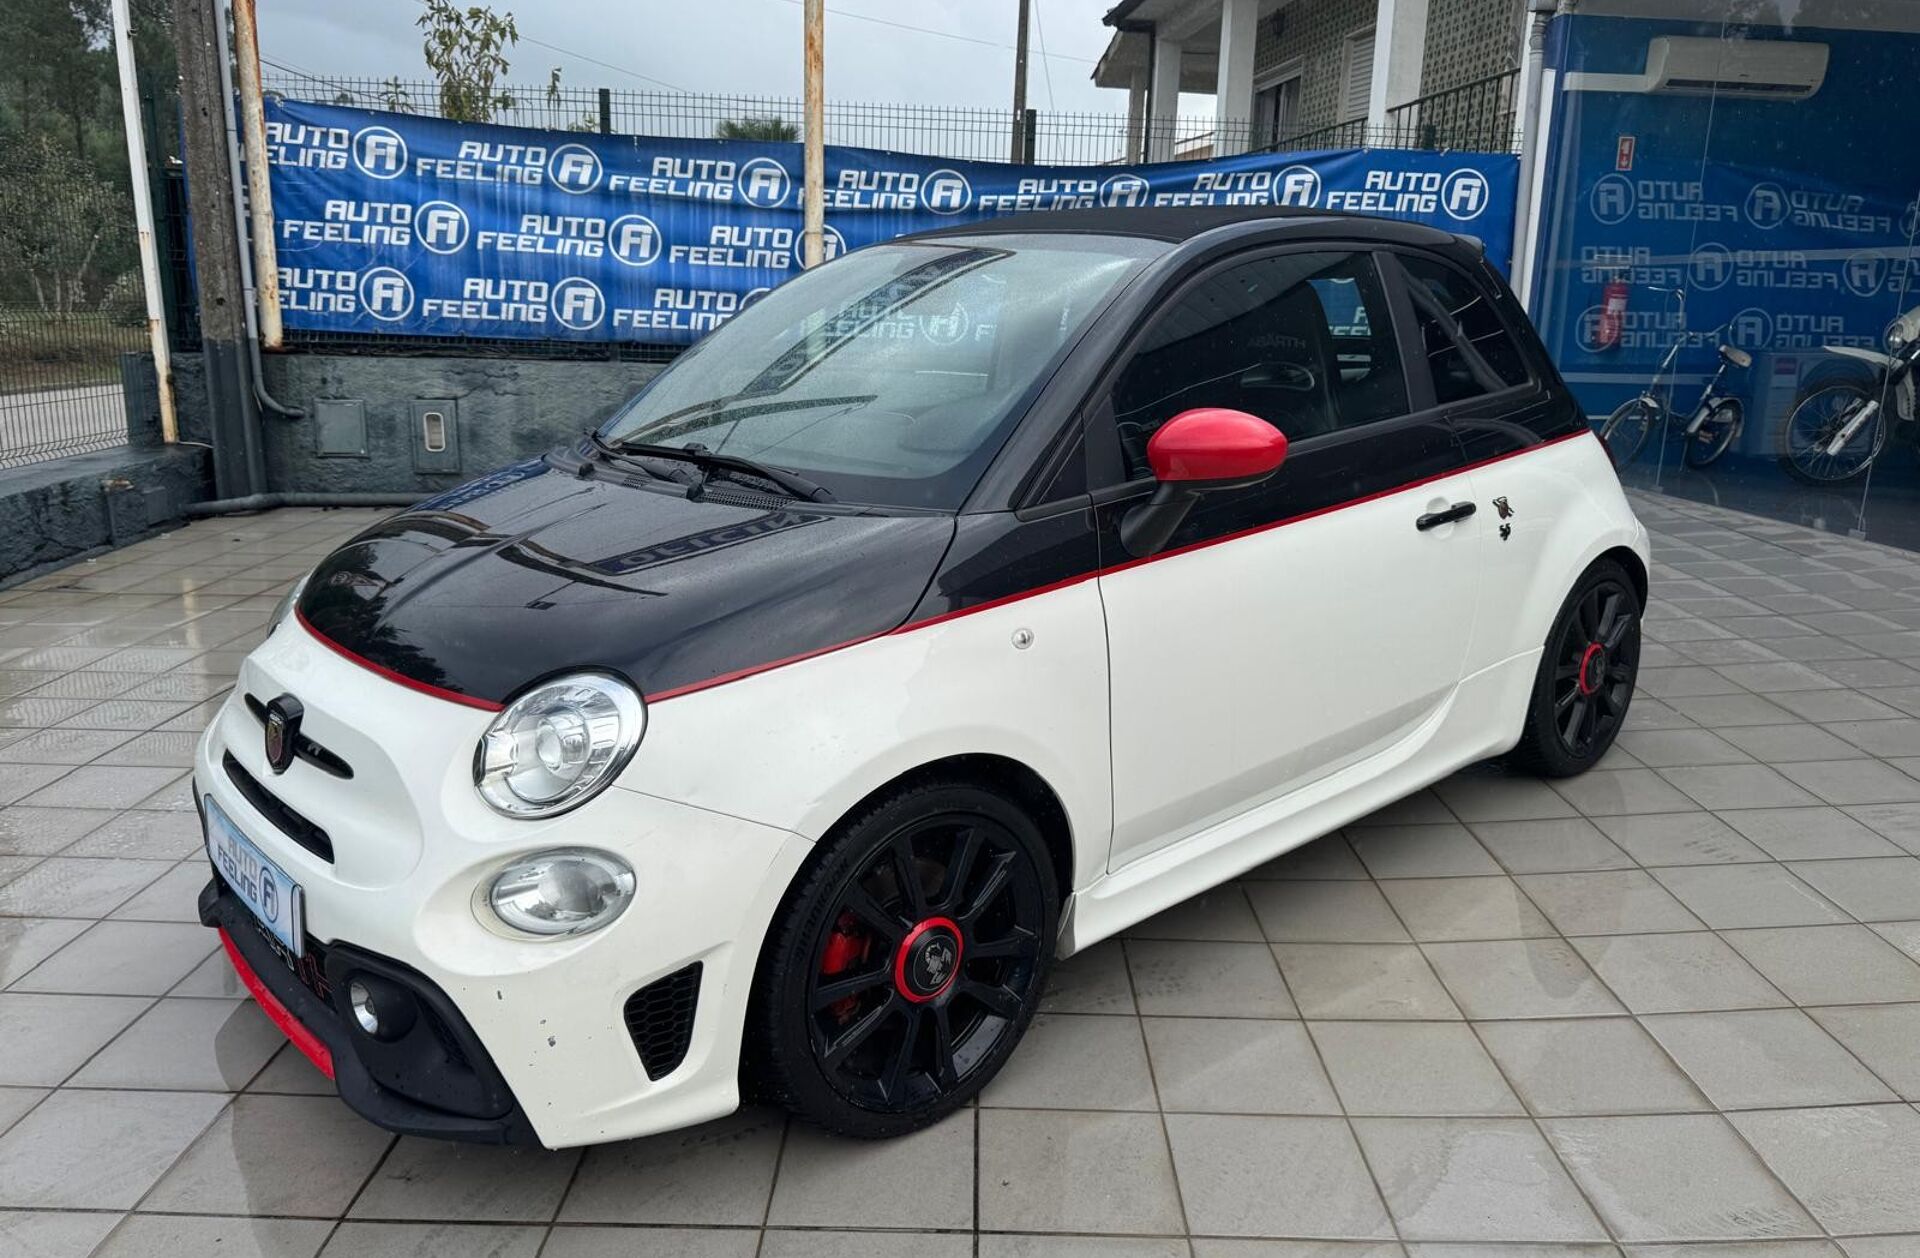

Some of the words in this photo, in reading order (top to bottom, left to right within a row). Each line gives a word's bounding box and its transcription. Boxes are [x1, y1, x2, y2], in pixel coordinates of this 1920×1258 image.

[459, 141, 546, 166] AUTO
[416, 158, 543, 184] FEELING
[652, 157, 736, 180] AUTO
[609, 175, 733, 200] FEELING
[838, 170, 919, 192] AUTO
[1018, 179, 1097, 194] AUTO
[1193, 172, 1271, 190] AUTO
[1365, 171, 1442, 192] AUTO
[325, 200, 412, 224] AUTO
[978, 194, 1095, 211] FEELING
[1326, 191, 1437, 212] FEELING
[283, 220, 410, 246] FEELING
[520, 214, 606, 239] AUTO
[710, 225, 793, 248] AUTO
[477, 231, 605, 257] FEELING
[670, 245, 790, 269] FEELING
[464, 278, 549, 302] AUTO
[654, 288, 737, 312] AUTO
[422, 299, 546, 323] FEELING
[218, 844, 257, 904] FEELING
